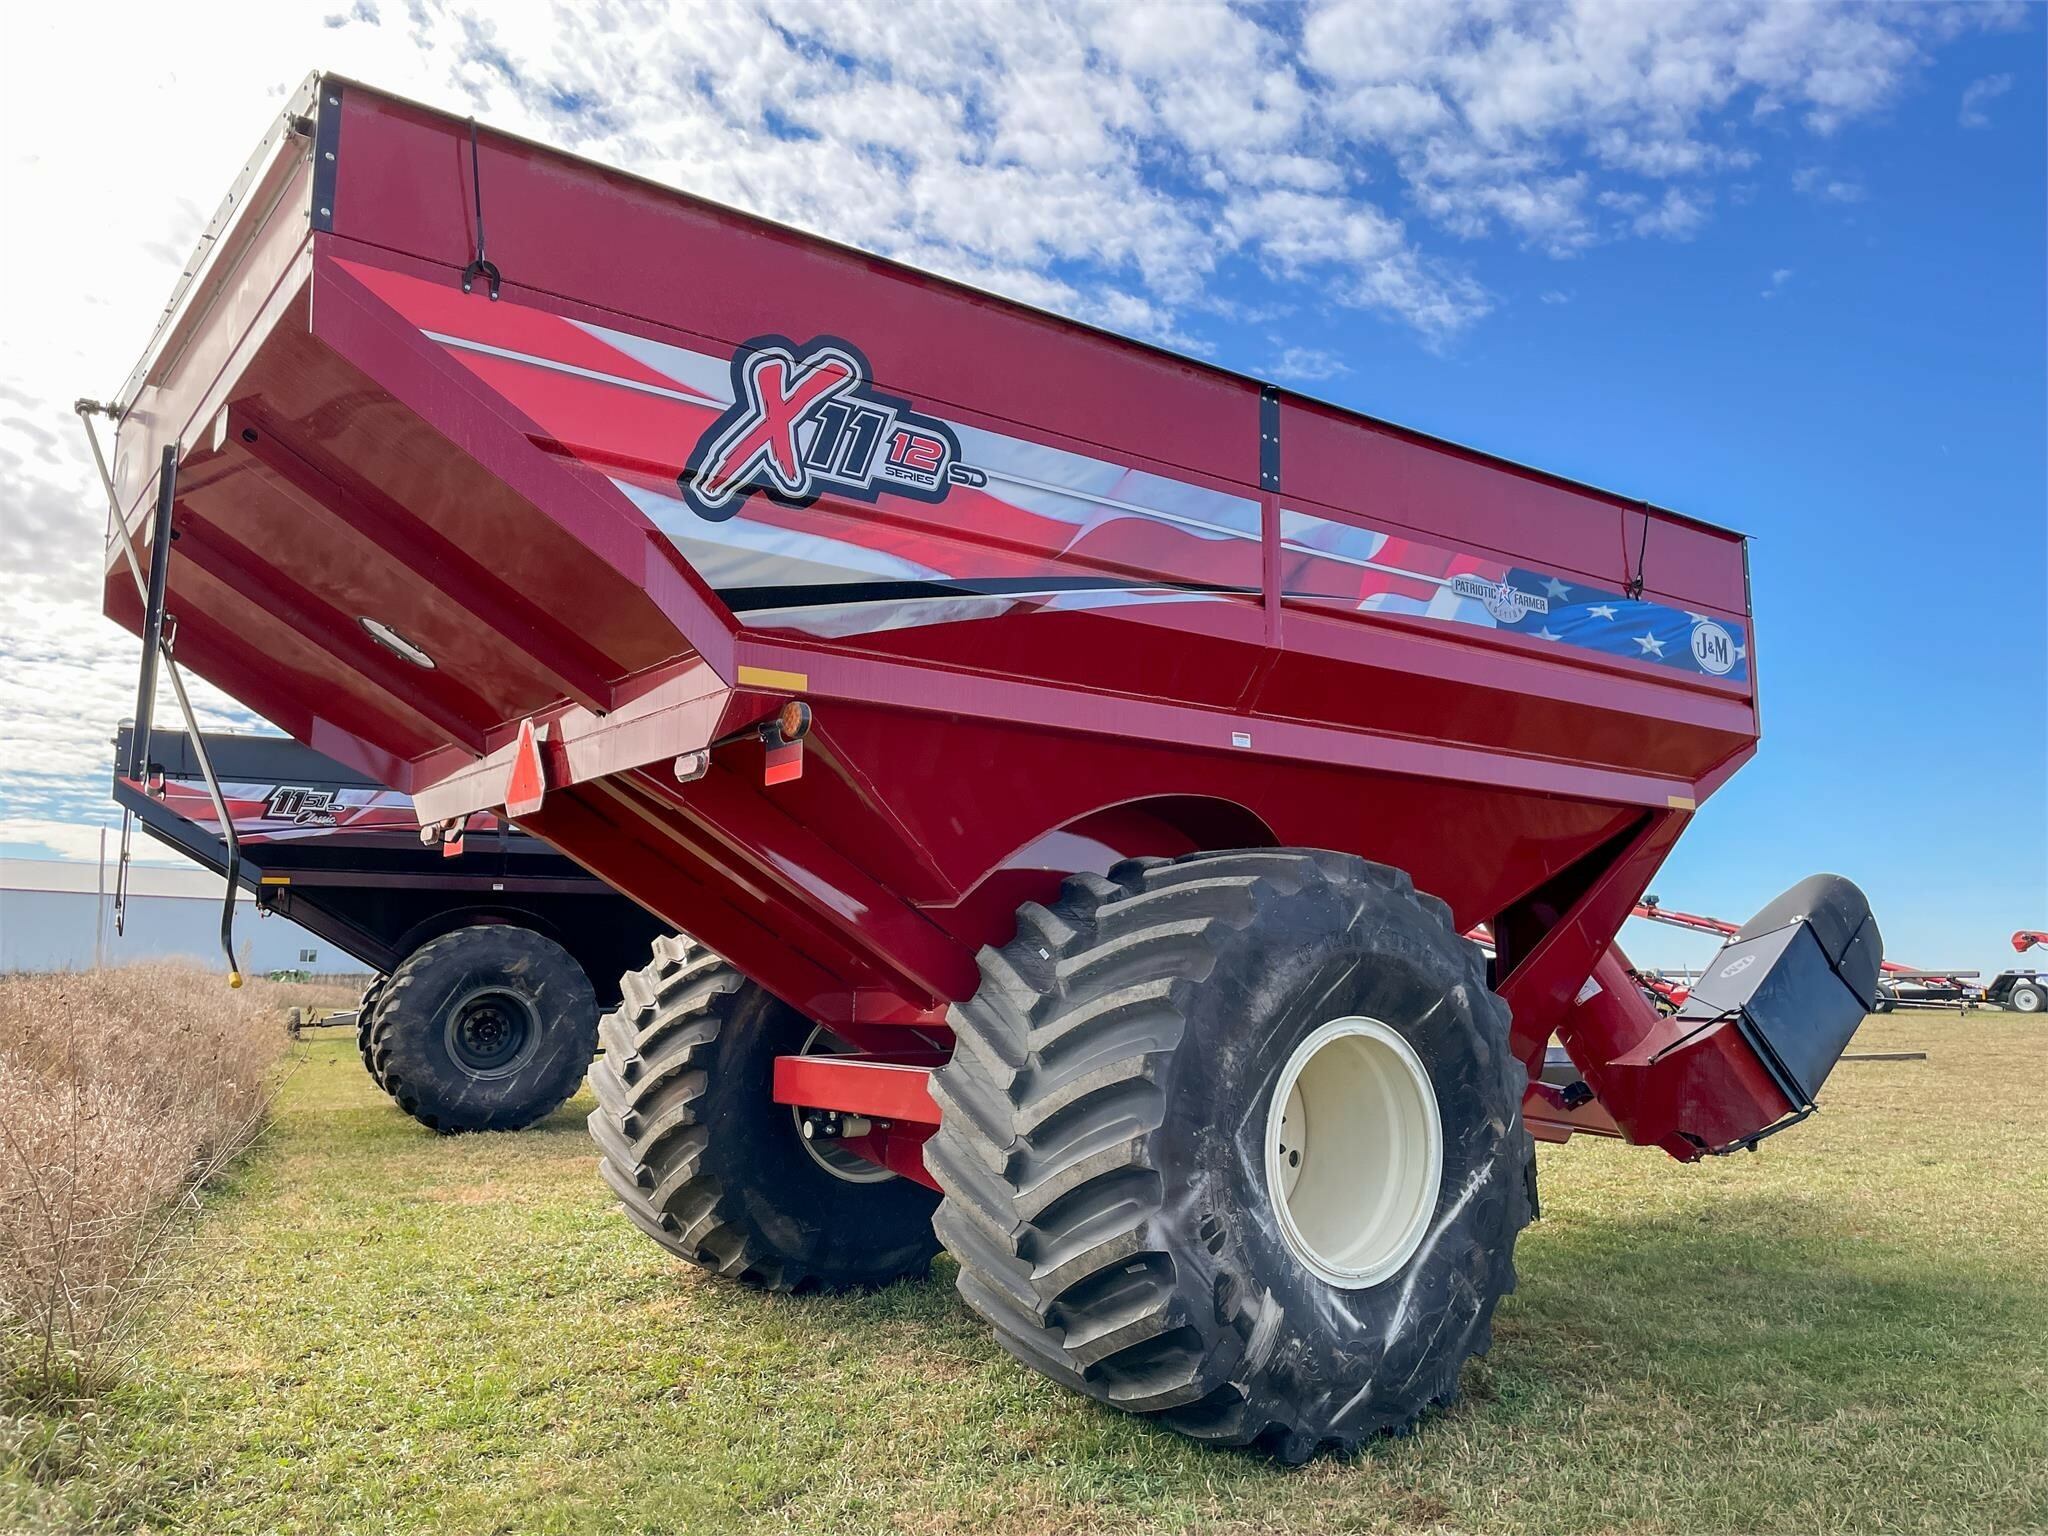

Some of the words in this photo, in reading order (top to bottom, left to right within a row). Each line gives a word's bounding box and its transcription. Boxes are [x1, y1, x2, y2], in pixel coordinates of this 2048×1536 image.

[885, 466, 935, 486] SERIES
[948, 463, 988, 488] SD
[1455, 579, 1497, 600] PATRIOTIC
[1514, 593, 1546, 611] FARMER
[1696, 632, 1729, 665] J&M
[293, 810, 337, 826] Classic
